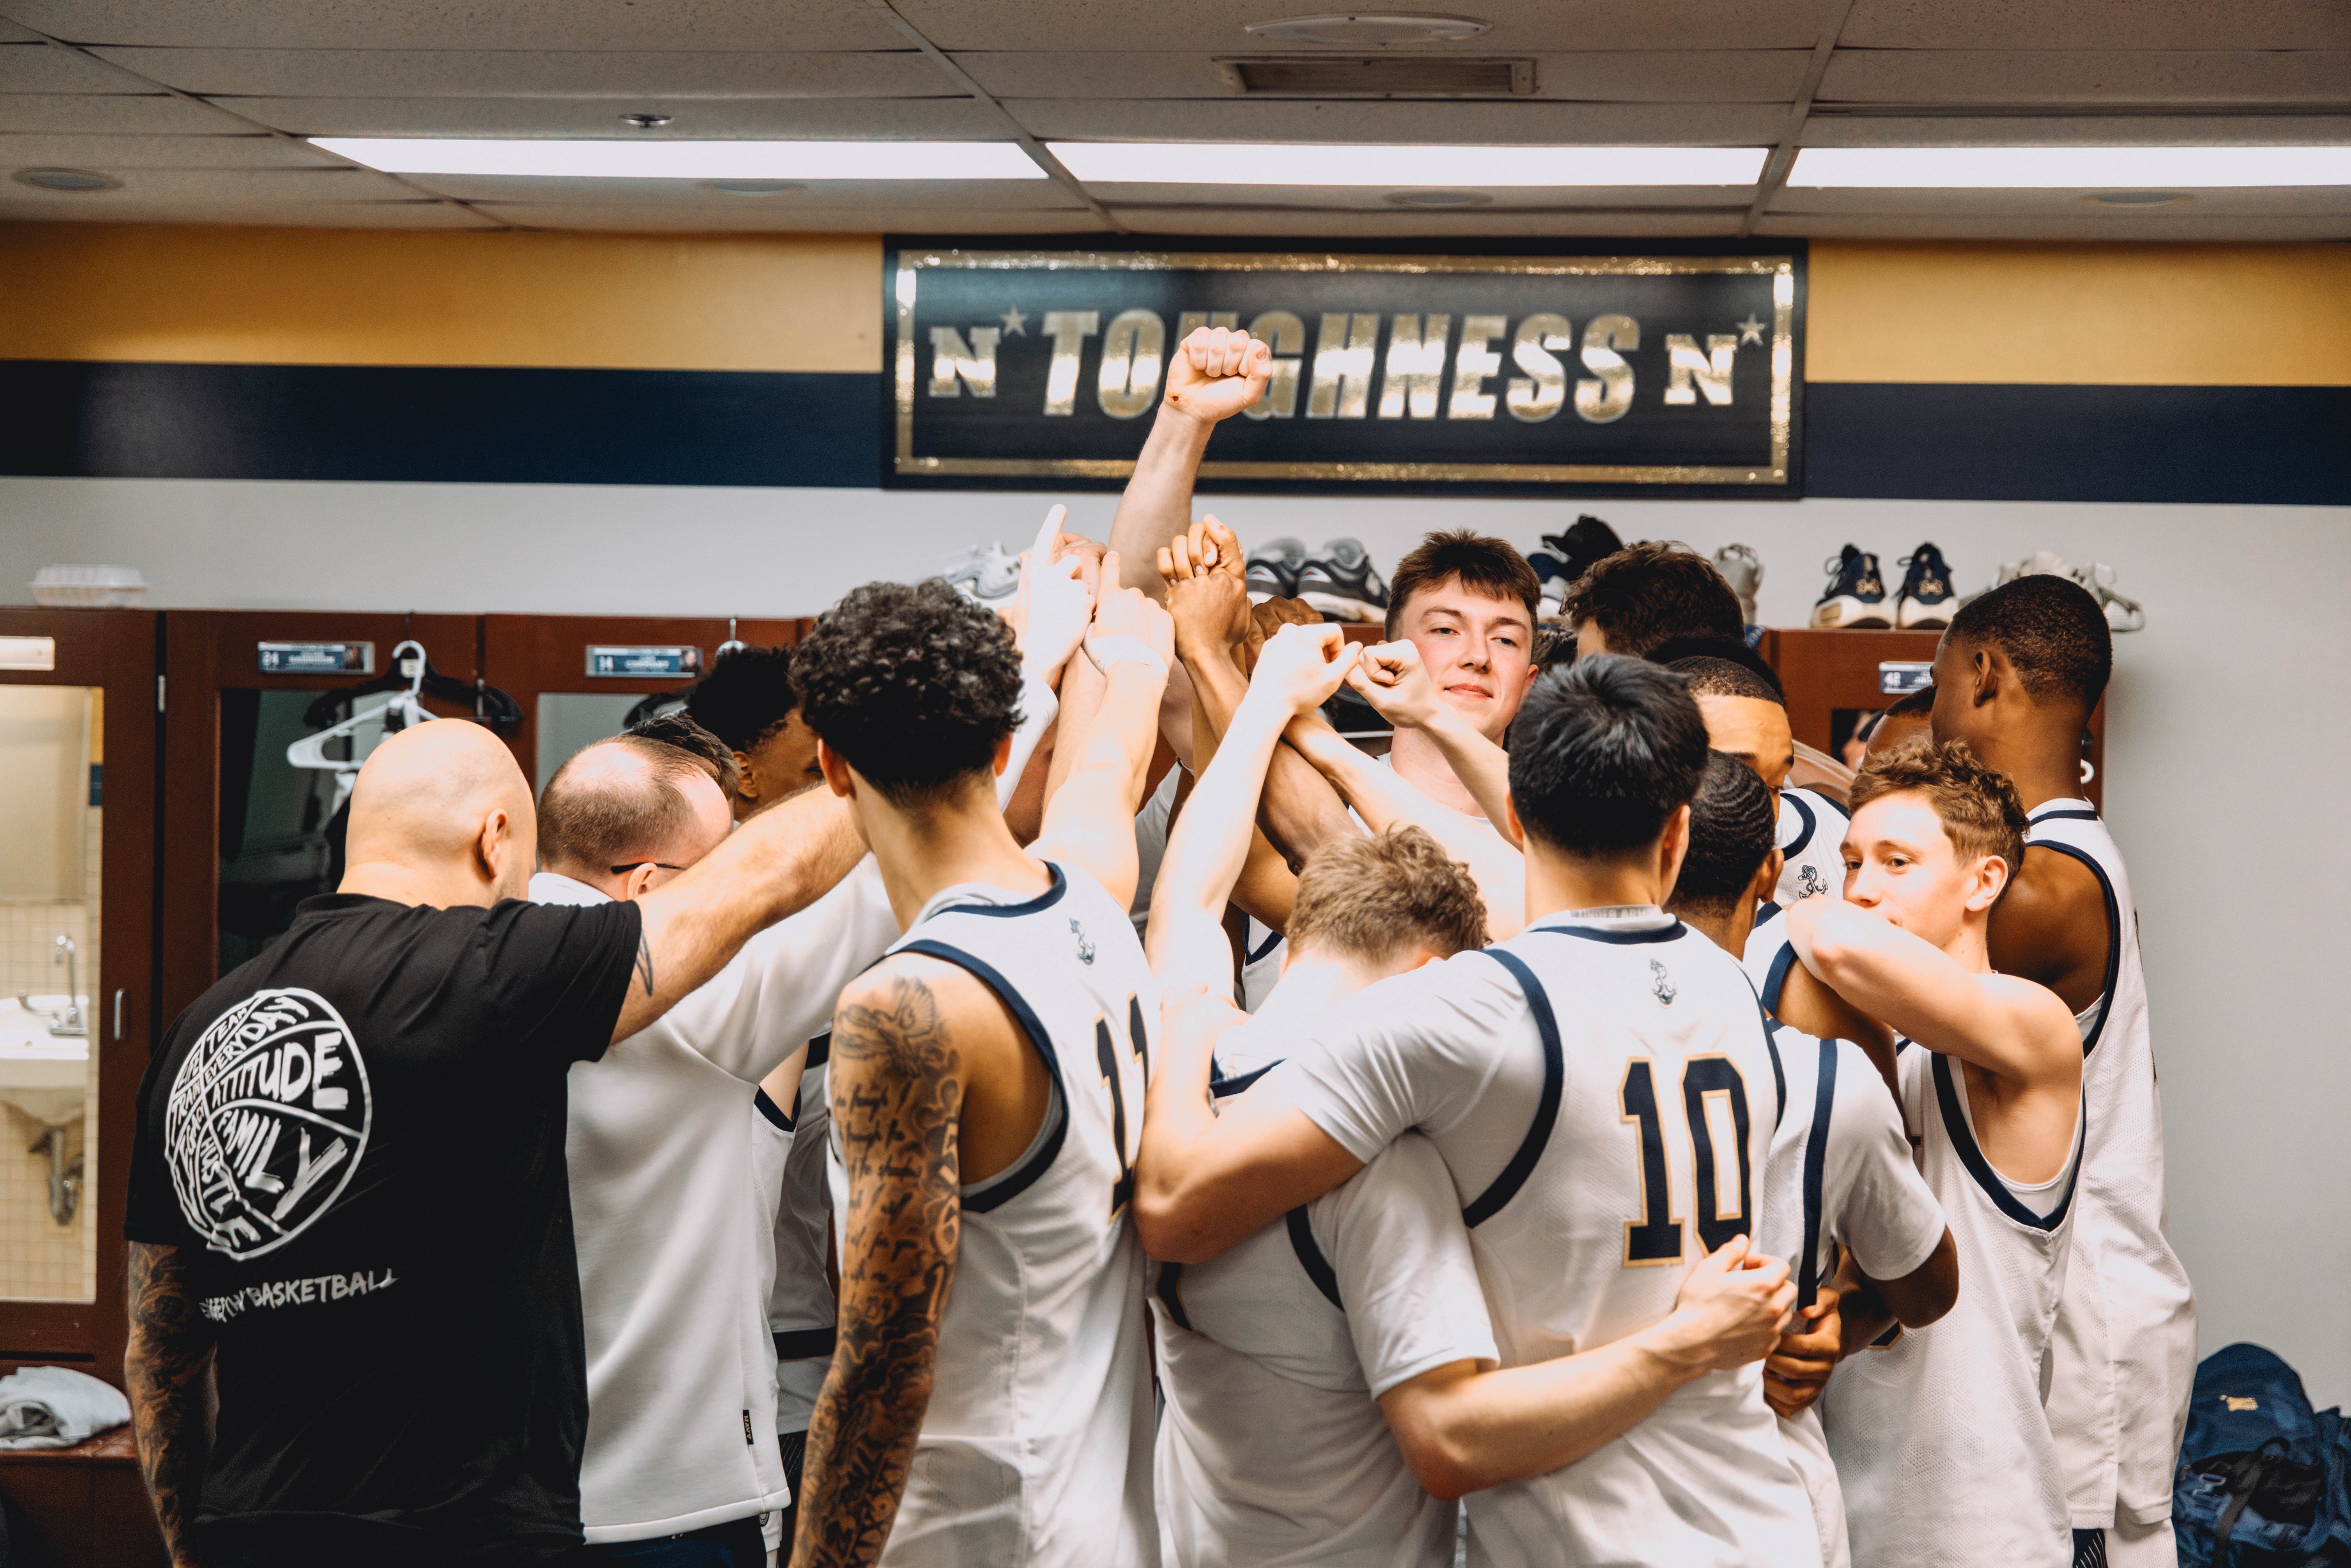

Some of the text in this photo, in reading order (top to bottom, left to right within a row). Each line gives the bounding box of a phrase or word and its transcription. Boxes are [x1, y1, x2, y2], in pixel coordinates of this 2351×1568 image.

[1042, 311, 1640, 424] TOGHNESS
[204, 996, 309, 1085] EVERYDAY
[206, 1007, 247, 1054] TEAM
[212, 1031, 349, 1110] ATTITUDE
[217, 1108, 348, 1221] FAMILY
[1618, 1051, 1752, 1267] 10
[744, 1415, 752, 1439] NAVY
